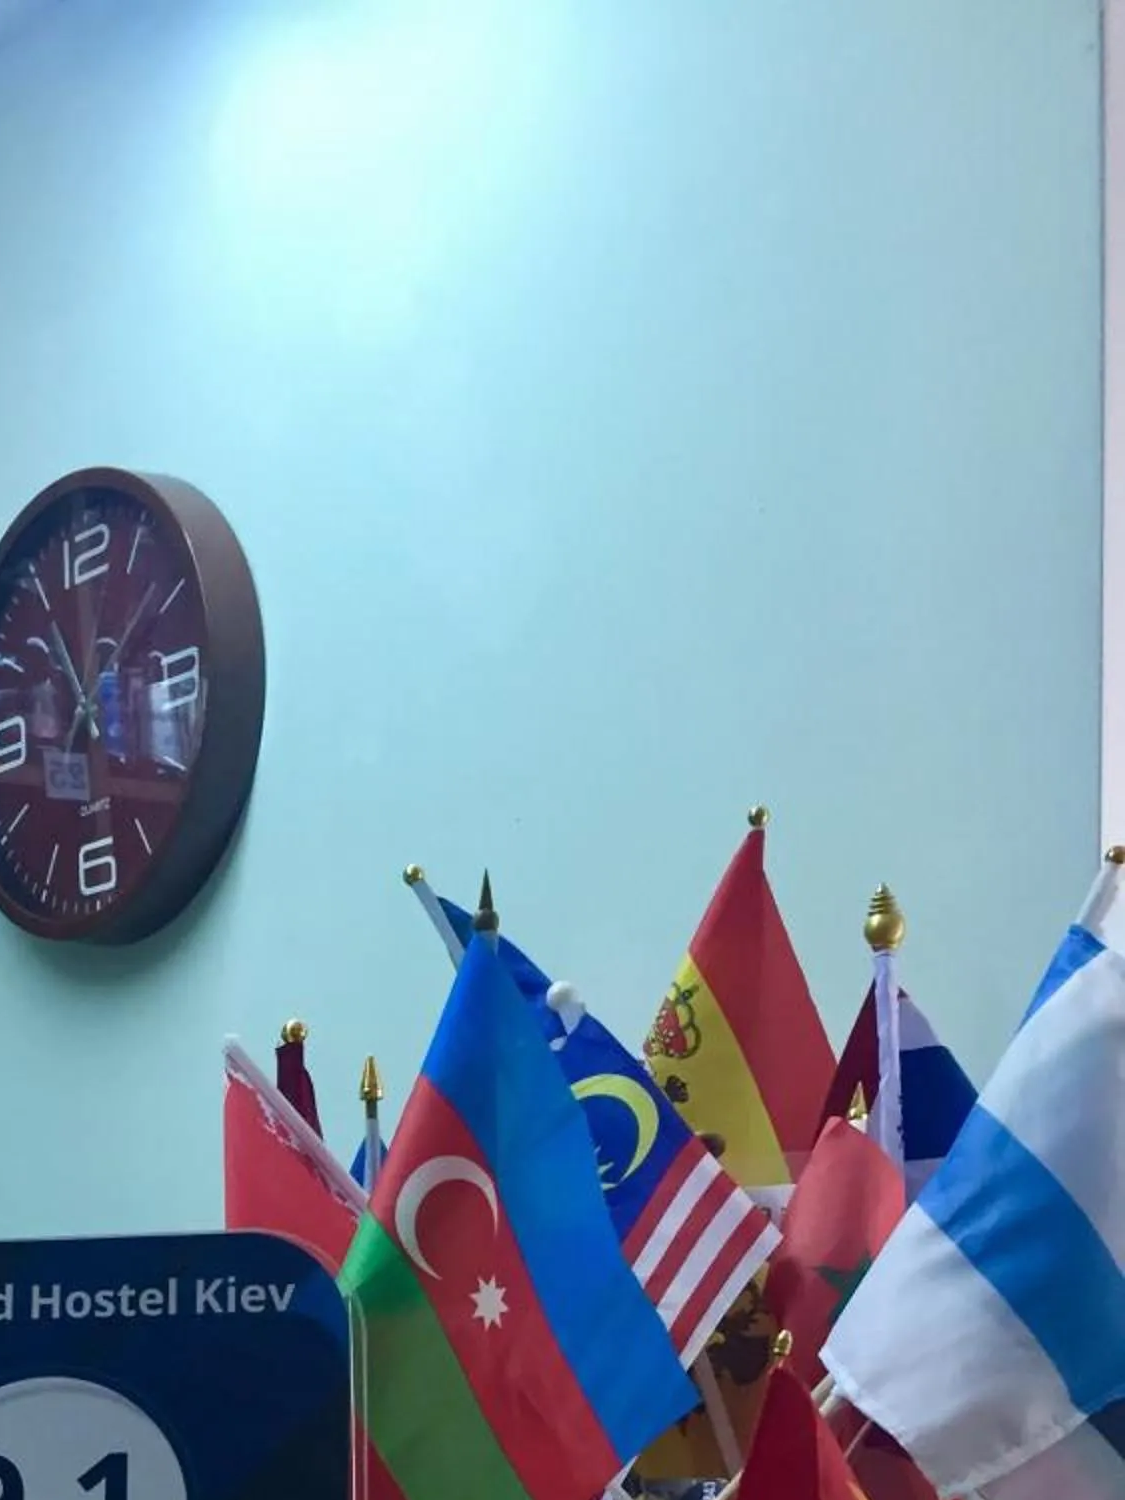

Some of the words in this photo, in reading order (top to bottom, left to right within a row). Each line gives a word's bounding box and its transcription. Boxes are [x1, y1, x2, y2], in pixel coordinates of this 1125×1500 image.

[62, 523, 111, 590] 12
[78, 836, 117, 896] 6
[31, 1277, 177, 1319] Hostel
[194, 1275, 296, 1315] Kiev
